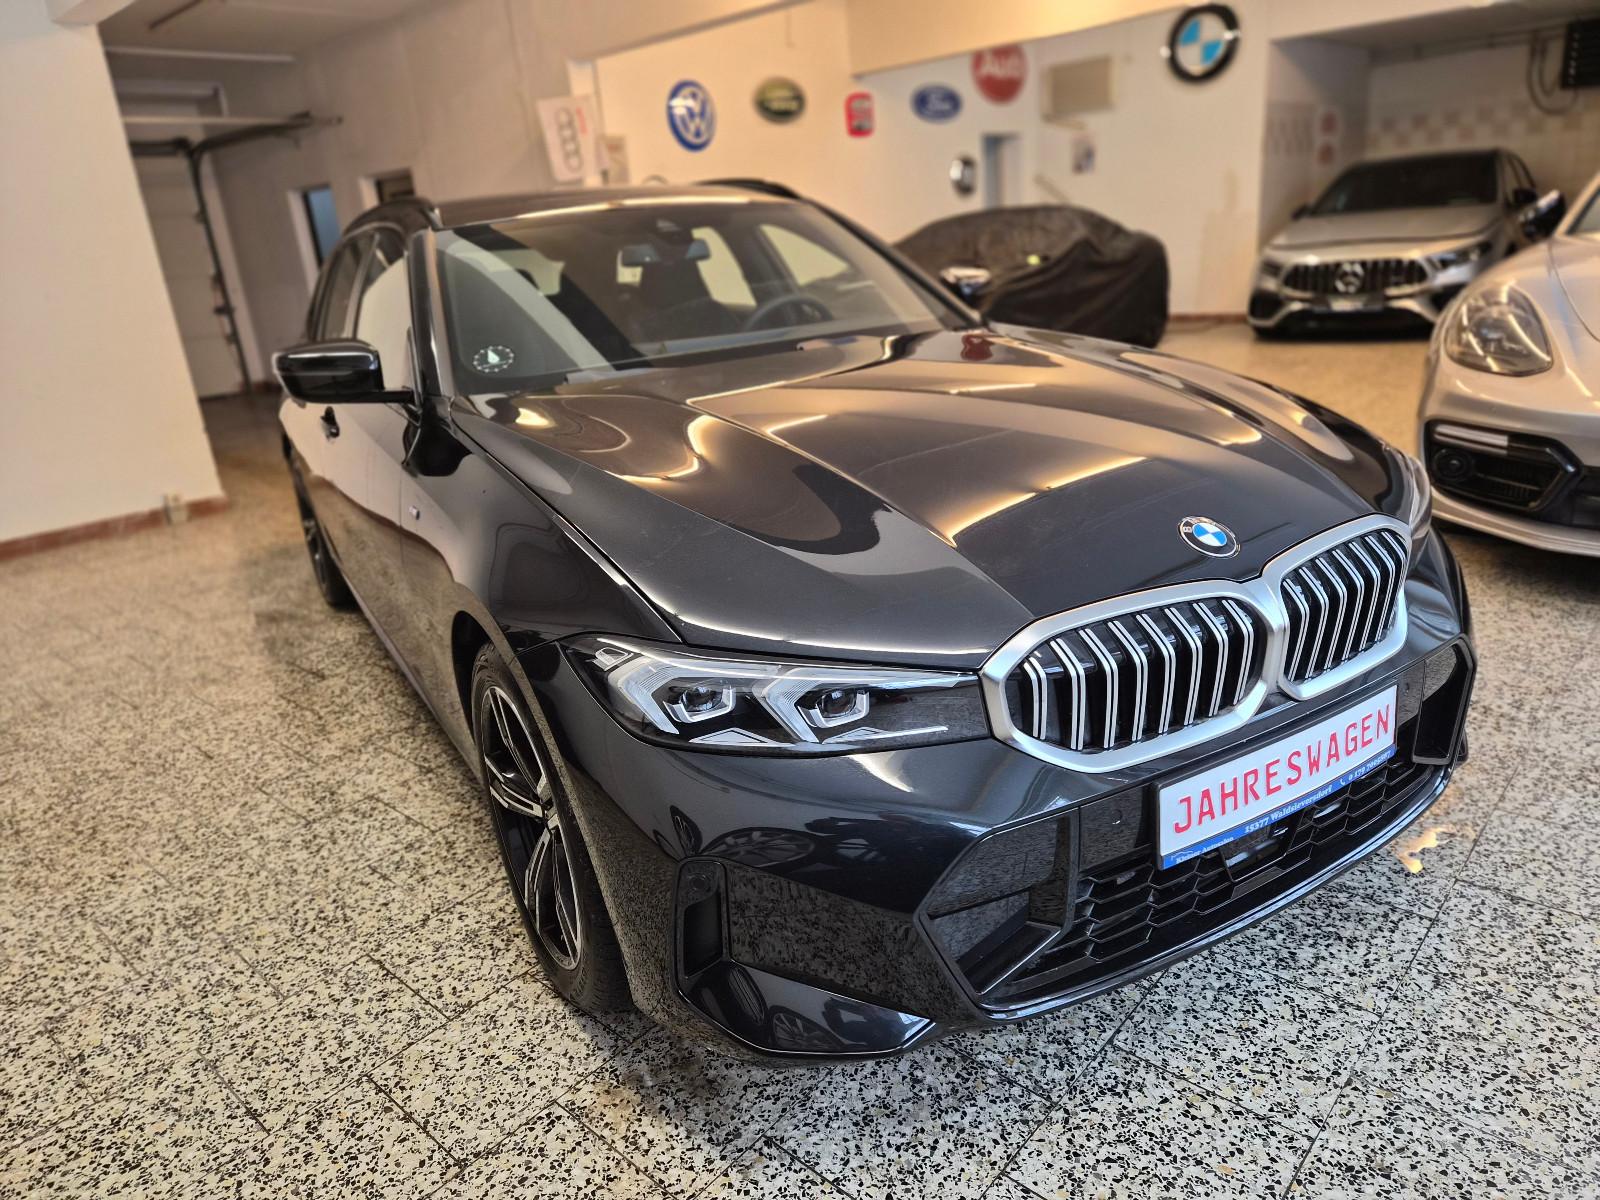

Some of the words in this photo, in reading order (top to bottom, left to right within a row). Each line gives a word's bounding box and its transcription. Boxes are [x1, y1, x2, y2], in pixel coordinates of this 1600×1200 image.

[1174, 704, 1390, 834] JAHRESWAGEN
[1244, 816, 1270, 833] 15377
[1270, 785, 1332, 821] Waldsieversdorf
